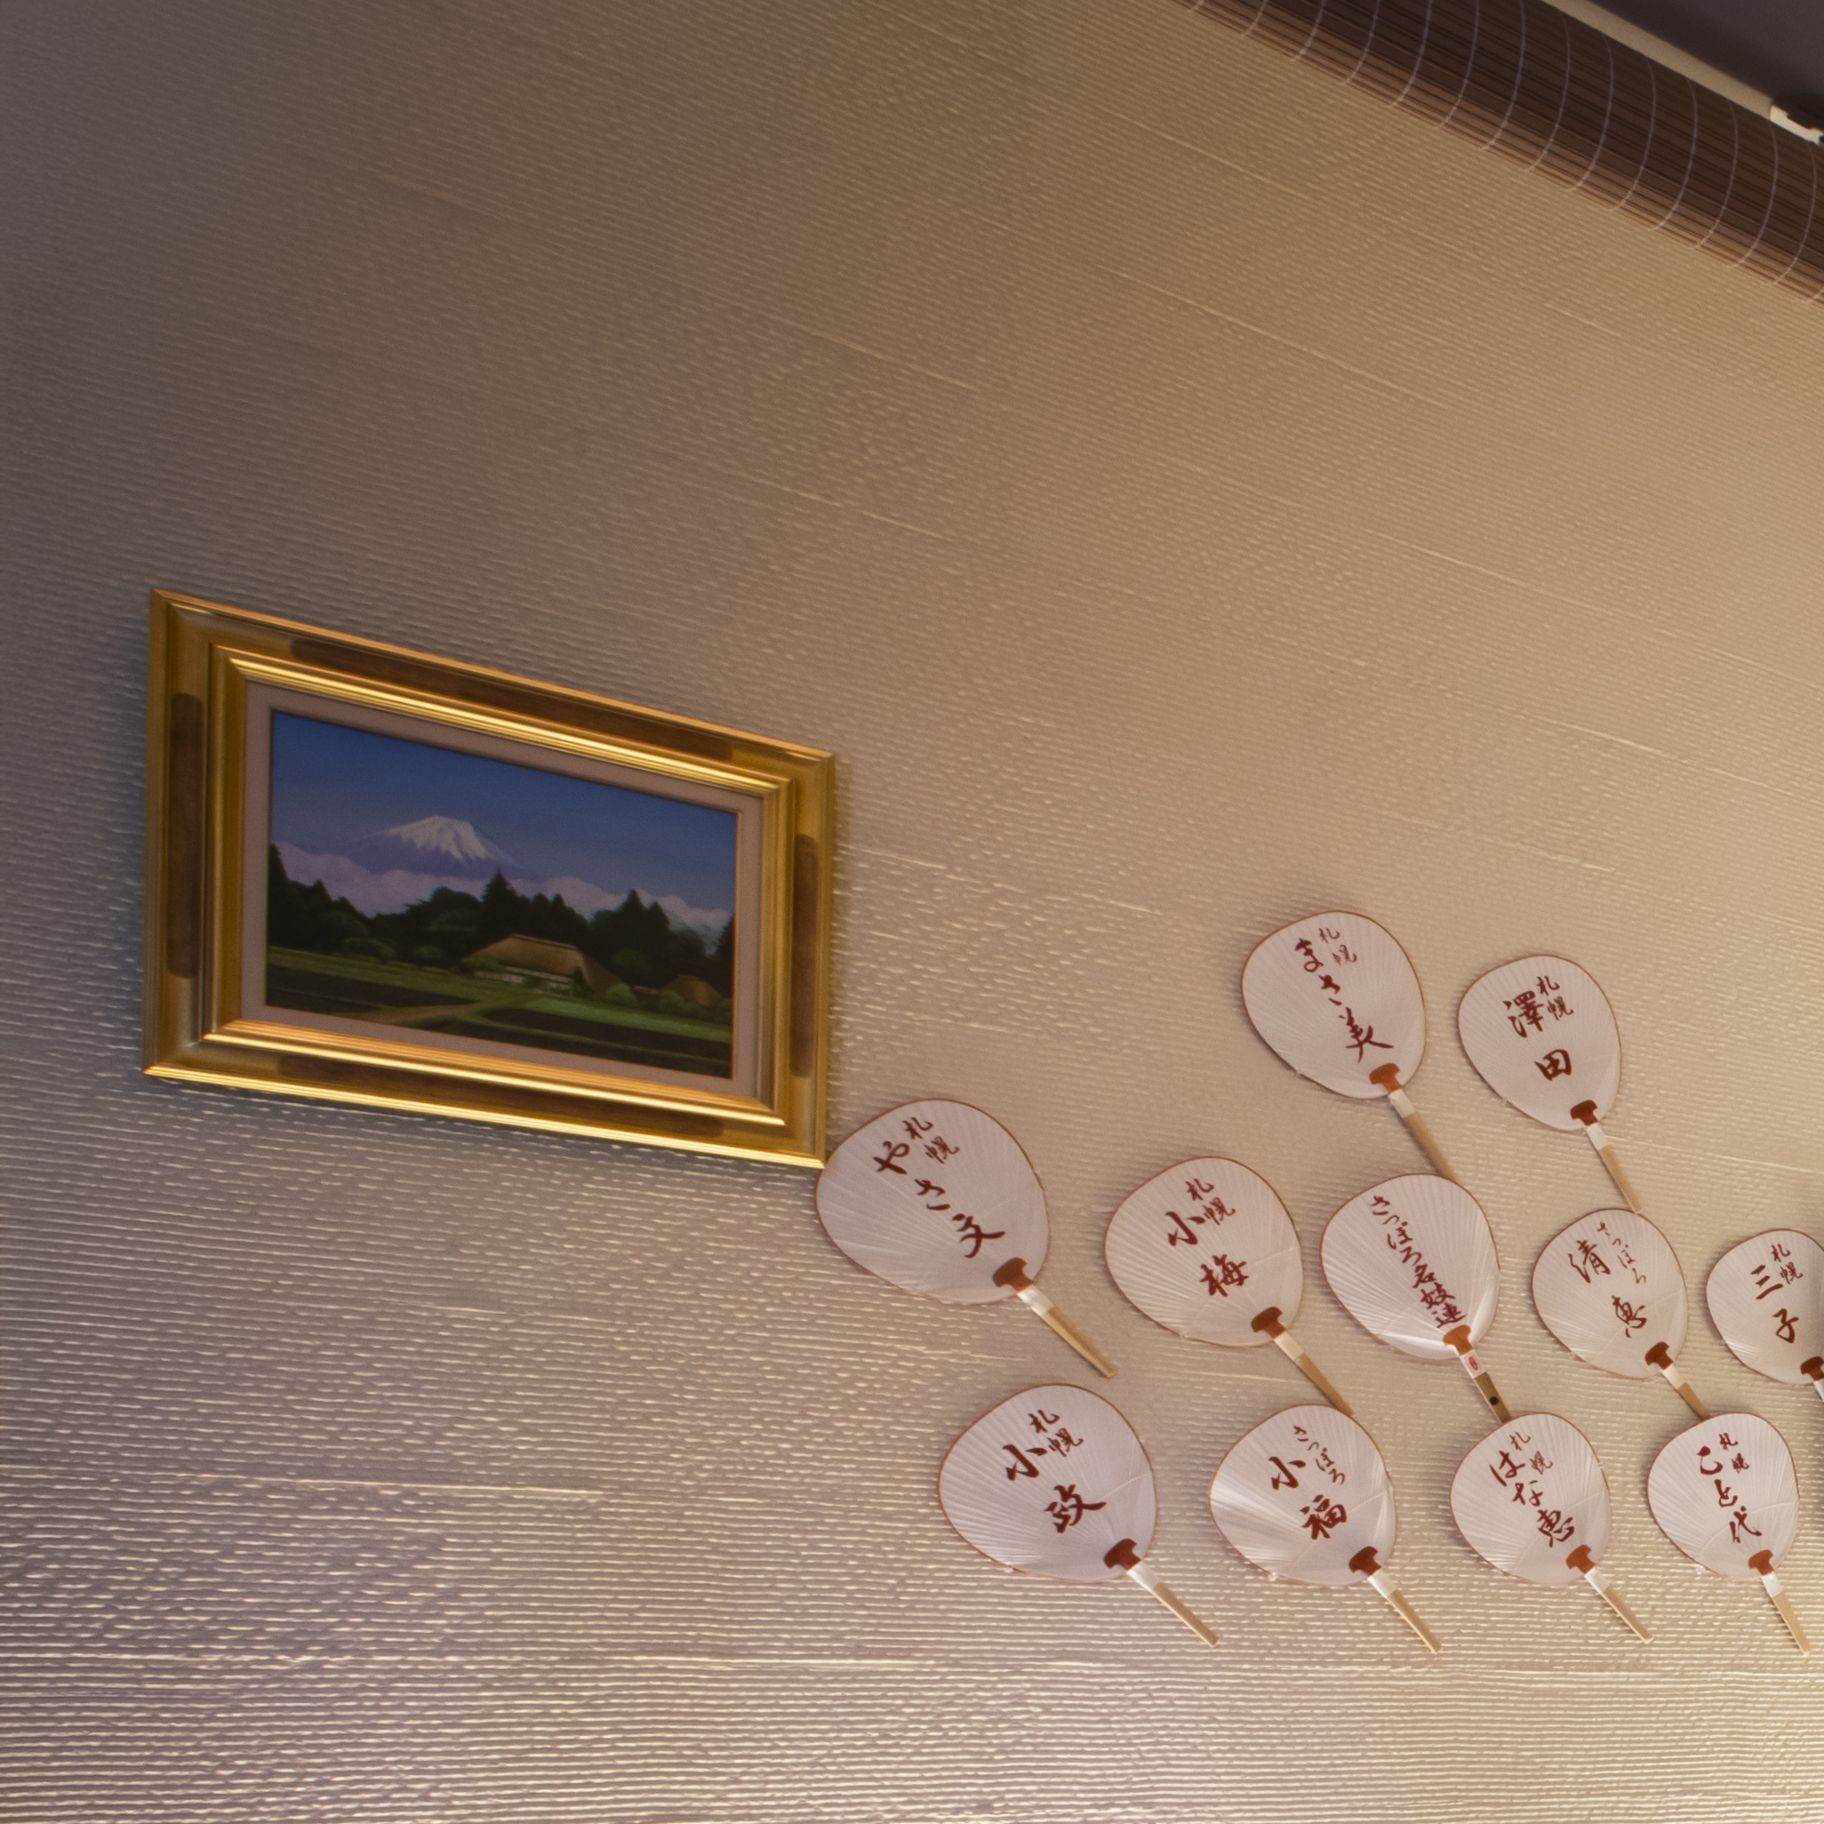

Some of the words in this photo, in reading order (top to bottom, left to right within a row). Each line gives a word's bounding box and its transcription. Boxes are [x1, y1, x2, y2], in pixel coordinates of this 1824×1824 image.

[1536, 975, 1574, 1021] 札幌
[902, 1116, 960, 1164] 札幌
[1185, 1177, 1236, 1225] 札幌
[1166, 1210, 1249, 1298] 小梅
[1770, 1242, 1804, 1286] 札幌
[1028, 1408, 1084, 1458] 札幌
[1269, 1455, 1350, 1540] 小福
